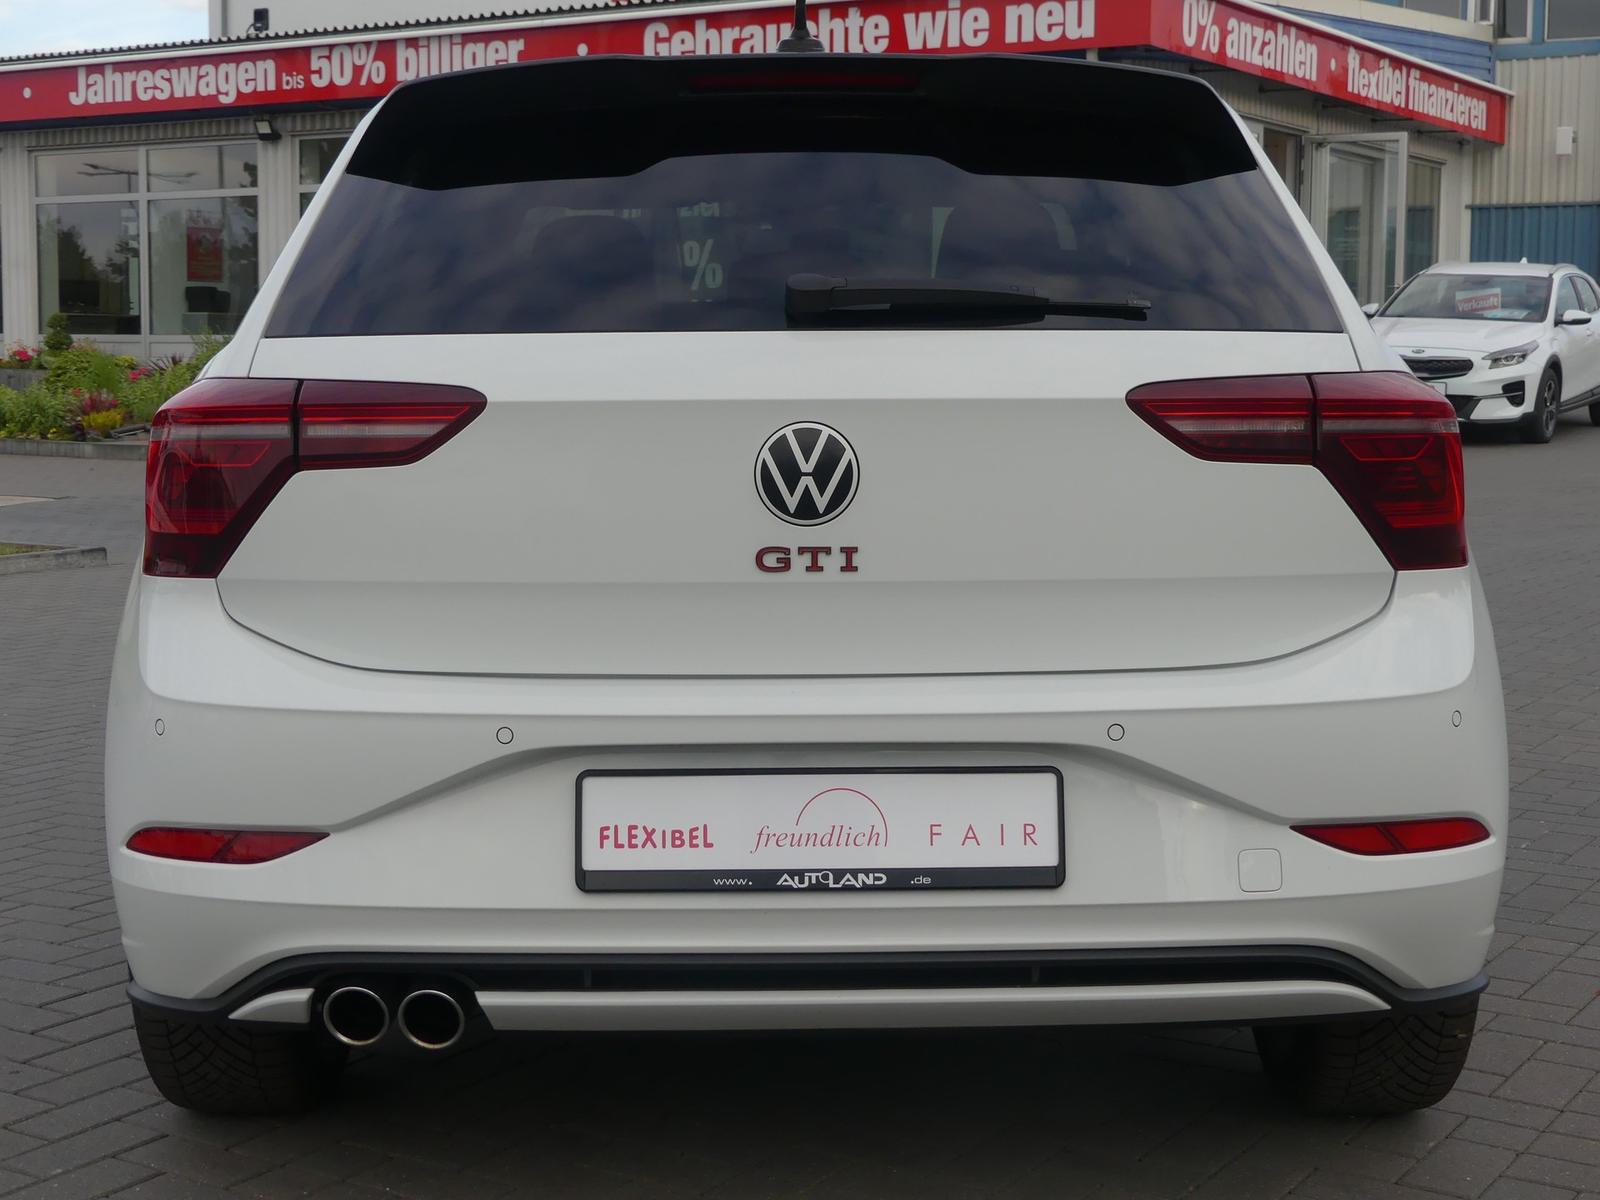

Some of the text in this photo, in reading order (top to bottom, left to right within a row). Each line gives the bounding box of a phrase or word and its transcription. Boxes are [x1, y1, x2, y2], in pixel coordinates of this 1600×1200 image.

[903, 0, 990, 50] wie
[1004, 0, 1095, 44] neu
[1182, 0, 1318, 82] 0% anzahlen
[68, 34, 525, 106] Jahreswagen bis 50% billiger
[1347, 46, 1487, 131] flexibel finanzieren
[755, 546, 859, 573] GTI
[750, 824, 881, 853] freundlich
[713, 871, 932, 889] www. AUTOLAND .de
